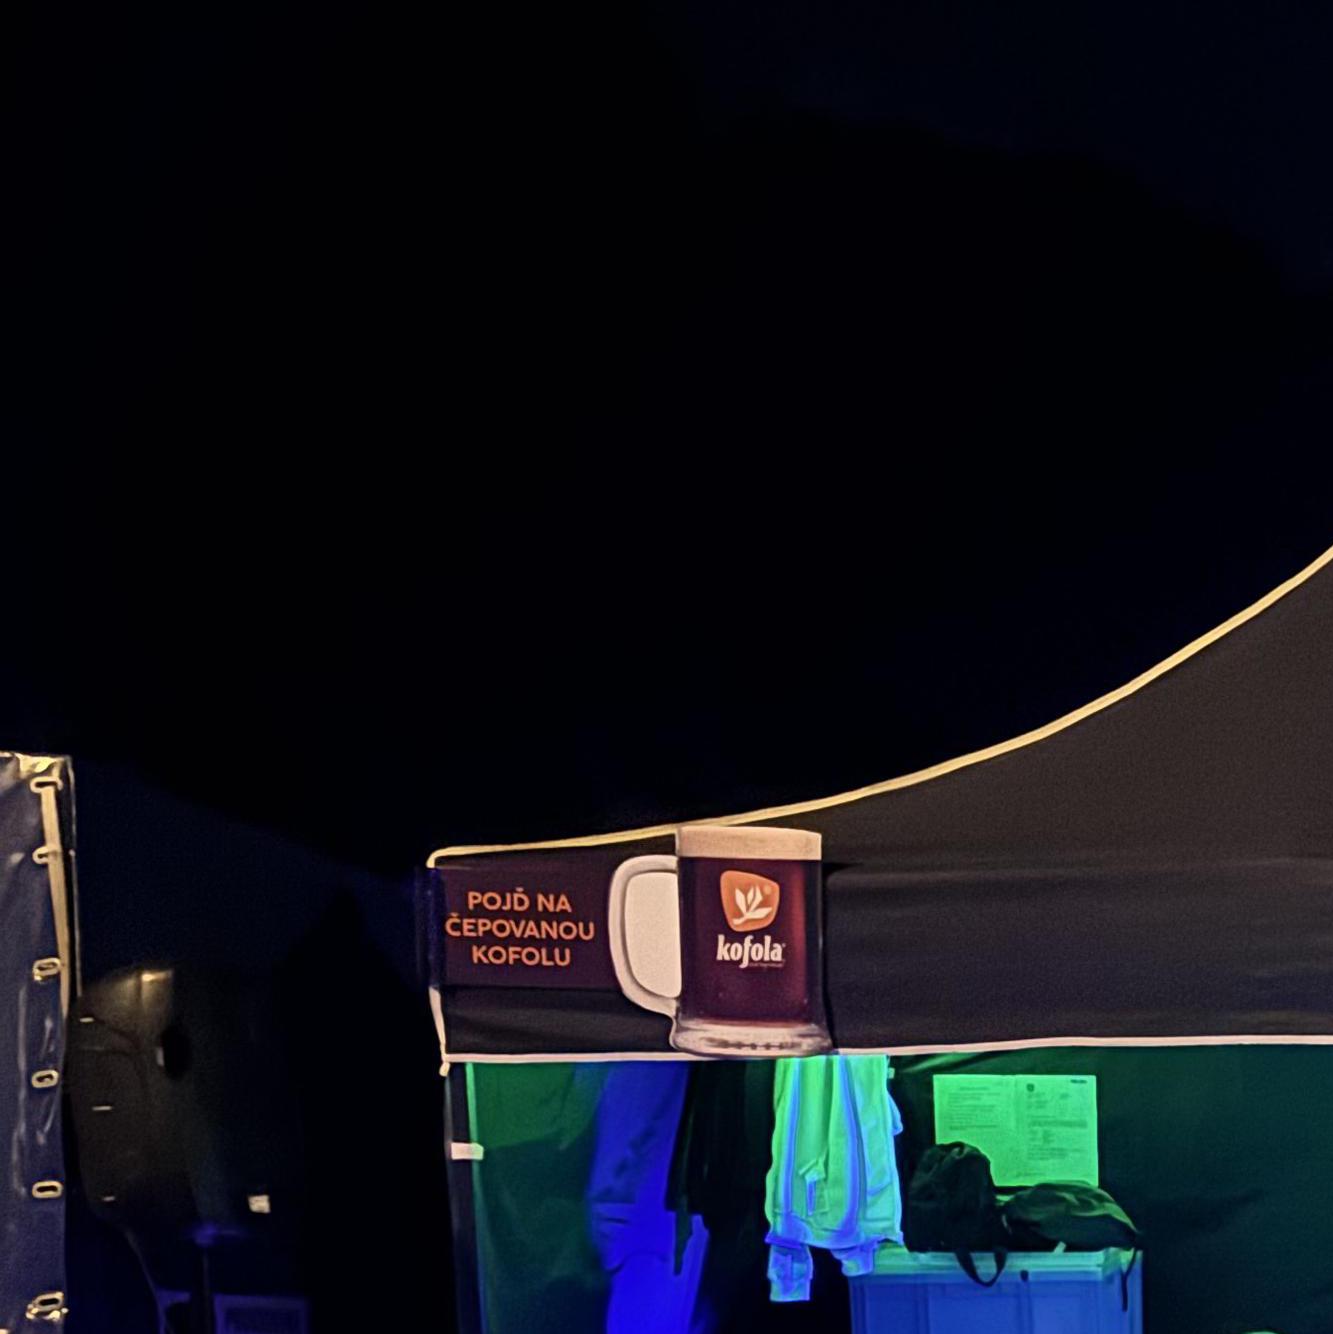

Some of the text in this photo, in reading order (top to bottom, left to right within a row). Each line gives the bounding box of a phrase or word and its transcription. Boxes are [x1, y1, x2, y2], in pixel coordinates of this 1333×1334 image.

[468, 888, 572, 913] POJĎ NA
[445, 913, 595, 941] ČEPOVANOU
[472, 945, 571, 966] KOFOLU
[716, 934, 784, 969] kofola
